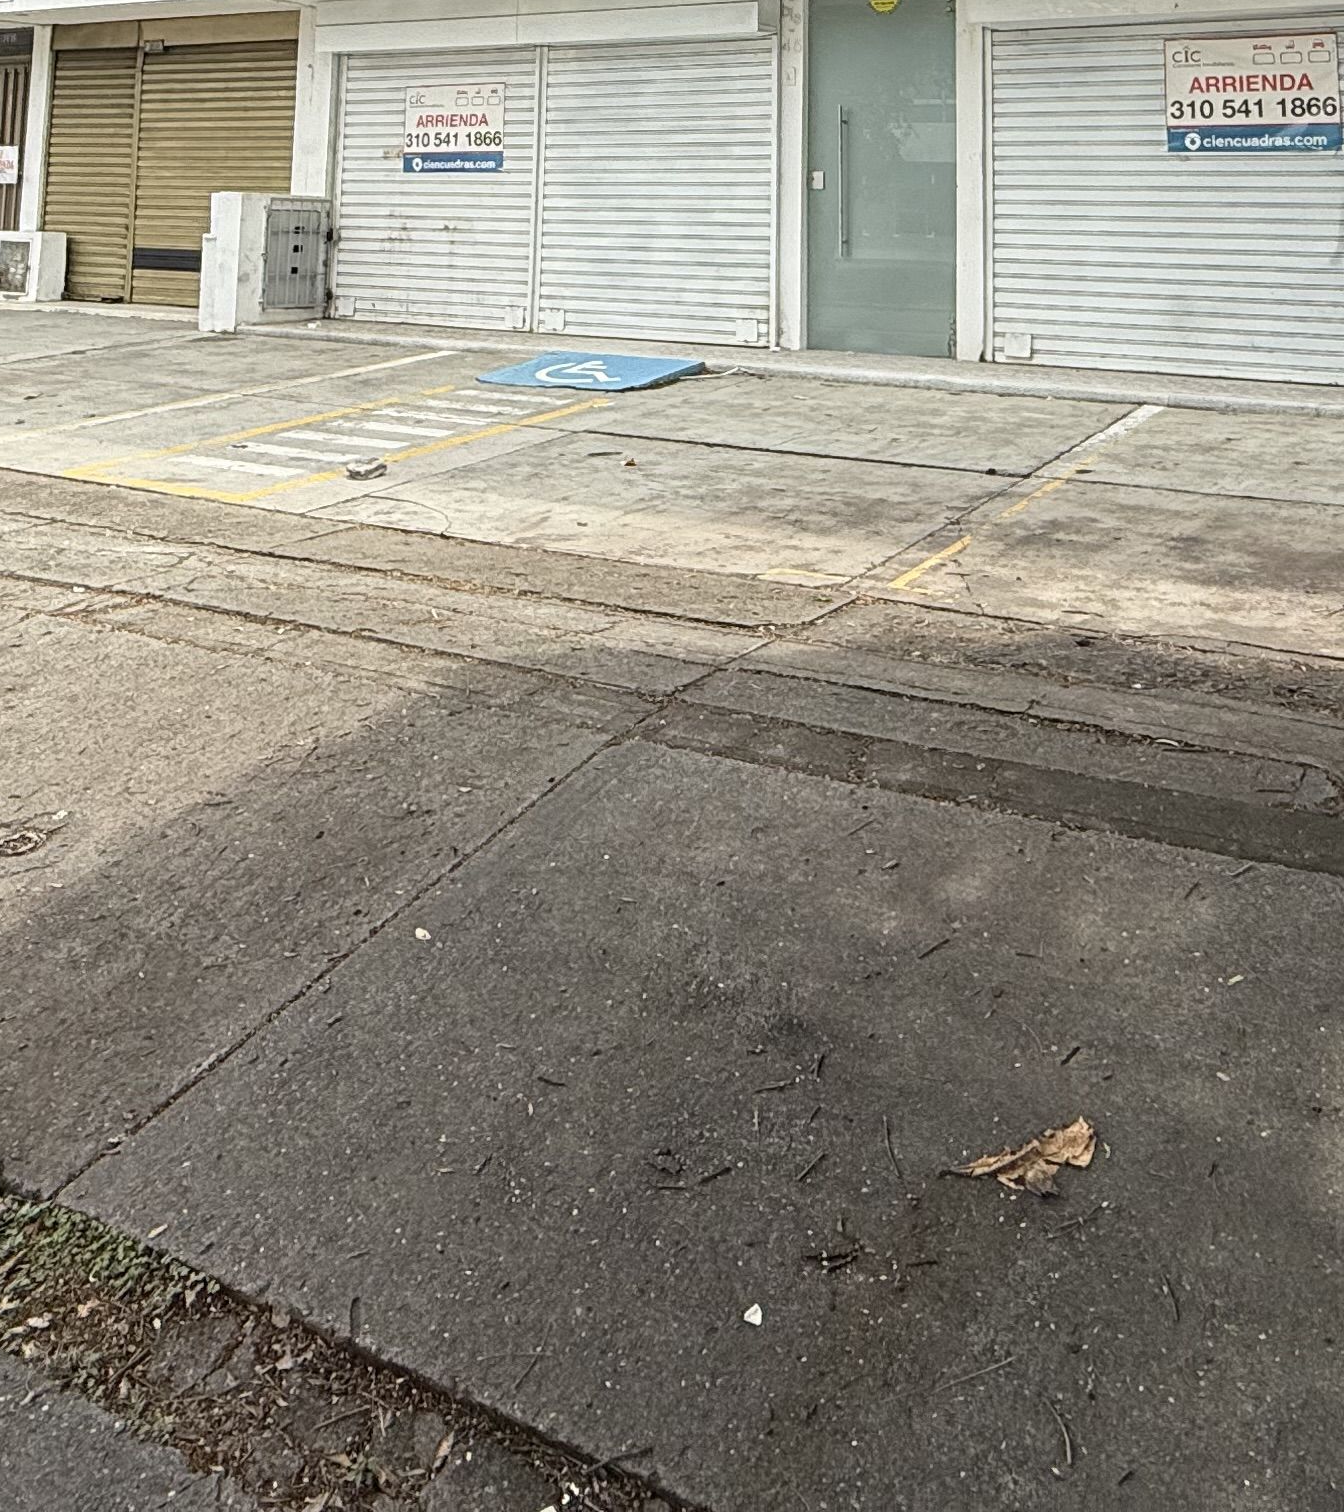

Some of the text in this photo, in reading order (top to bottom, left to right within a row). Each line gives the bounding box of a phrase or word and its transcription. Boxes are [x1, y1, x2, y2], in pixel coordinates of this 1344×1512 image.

[1188, 73, 1314, 94] ARRIENDA
[1170, 96, 1338, 120] 310 541 1866
[416, 113, 489, 128] ARRIENDA
[406, 130, 502, 148] 310 541 1866
